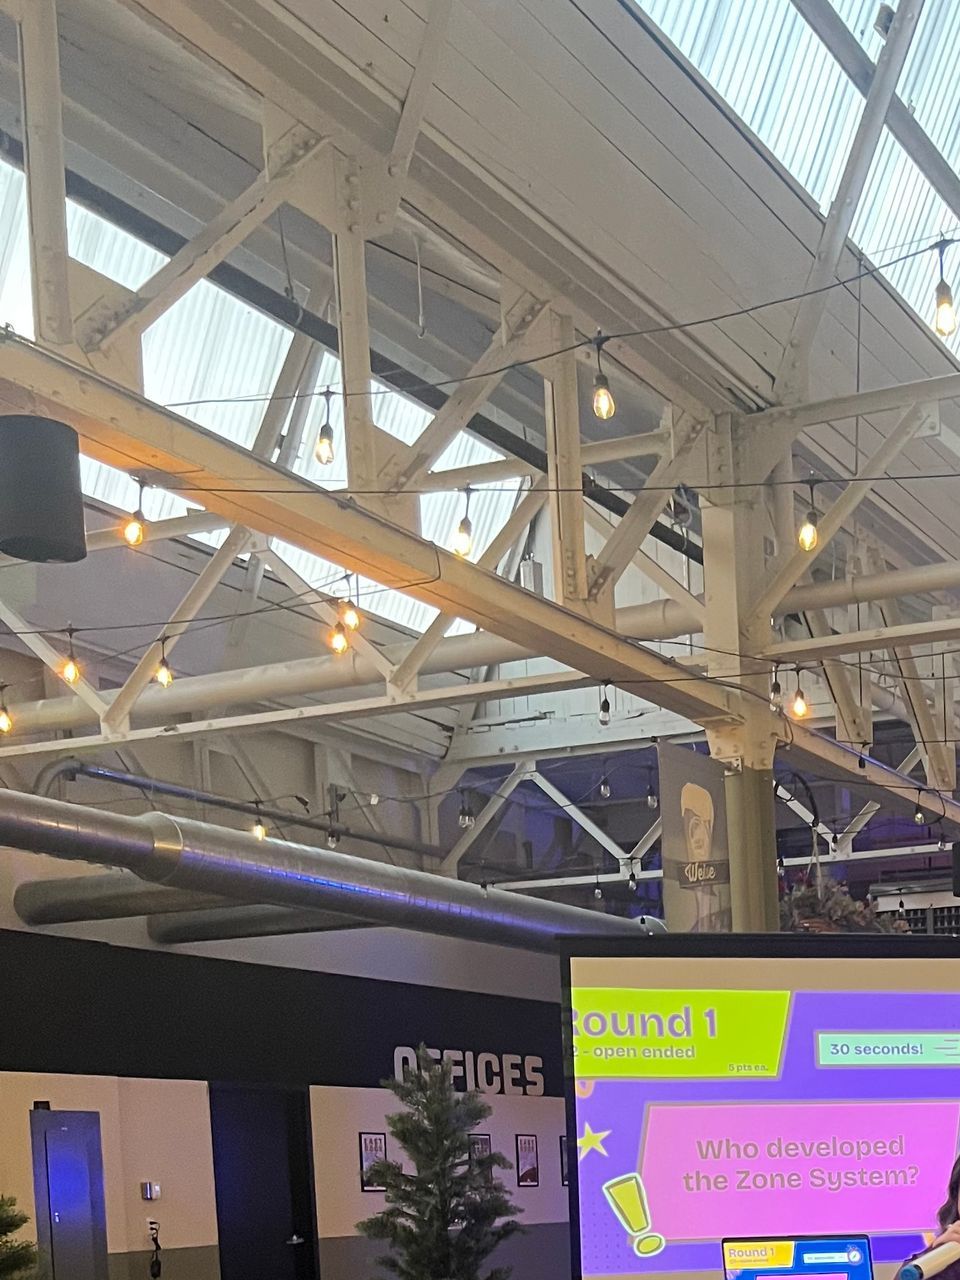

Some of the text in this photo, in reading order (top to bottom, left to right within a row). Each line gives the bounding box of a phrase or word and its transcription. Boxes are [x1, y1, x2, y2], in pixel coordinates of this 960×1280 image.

[703, 1008, 717, 1038] 1
[593, 1046, 637, 1060] open
[641, 1045, 696, 1058] ended
[830, 1042, 924, 1055] 30 seconds!
[736, 1063, 752, 1073] pts
[697, 1135, 905, 1161] Who developed
[682, 1166, 919, 1192] the Zone System?
[728, 1247, 775, 1258] Round 1
